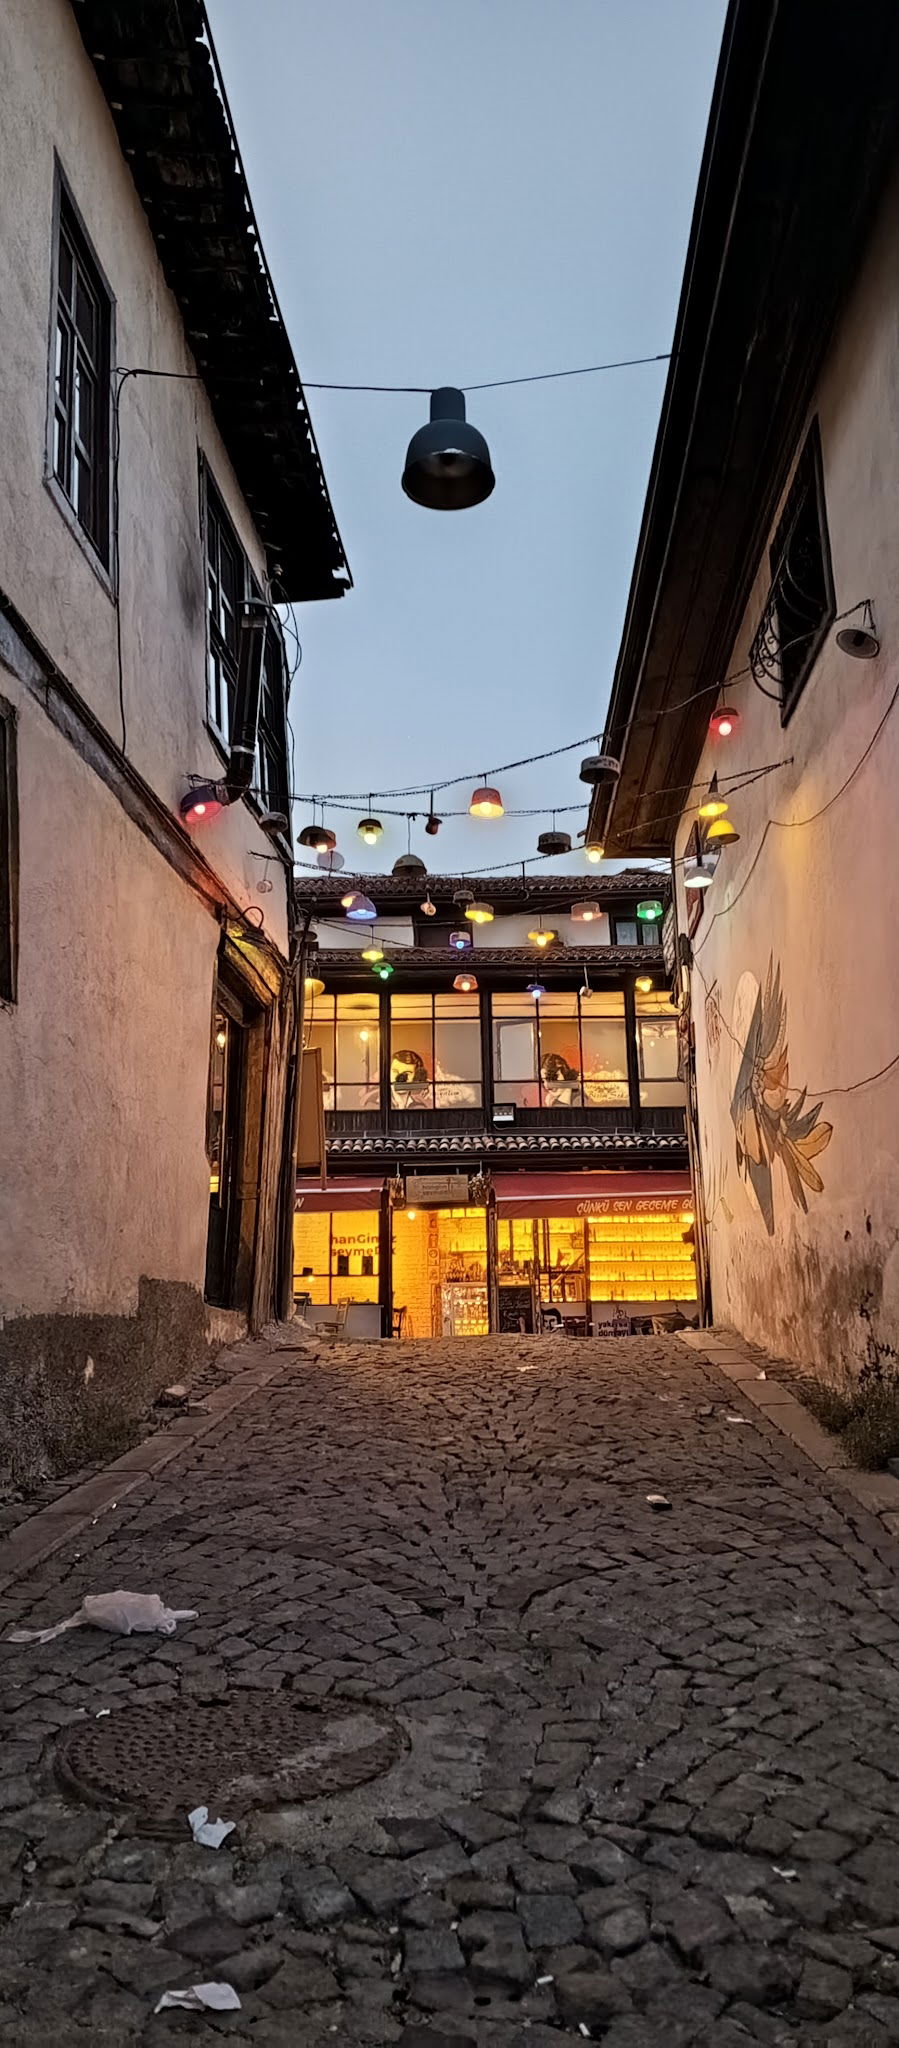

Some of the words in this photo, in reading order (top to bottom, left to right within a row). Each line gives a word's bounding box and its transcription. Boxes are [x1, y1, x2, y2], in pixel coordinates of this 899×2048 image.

[577, 1200, 609, 1215] ÇÜNKÜ
[613, 1200, 632, 1212] SEN
[331, 1232, 396, 1244] hanGimz
